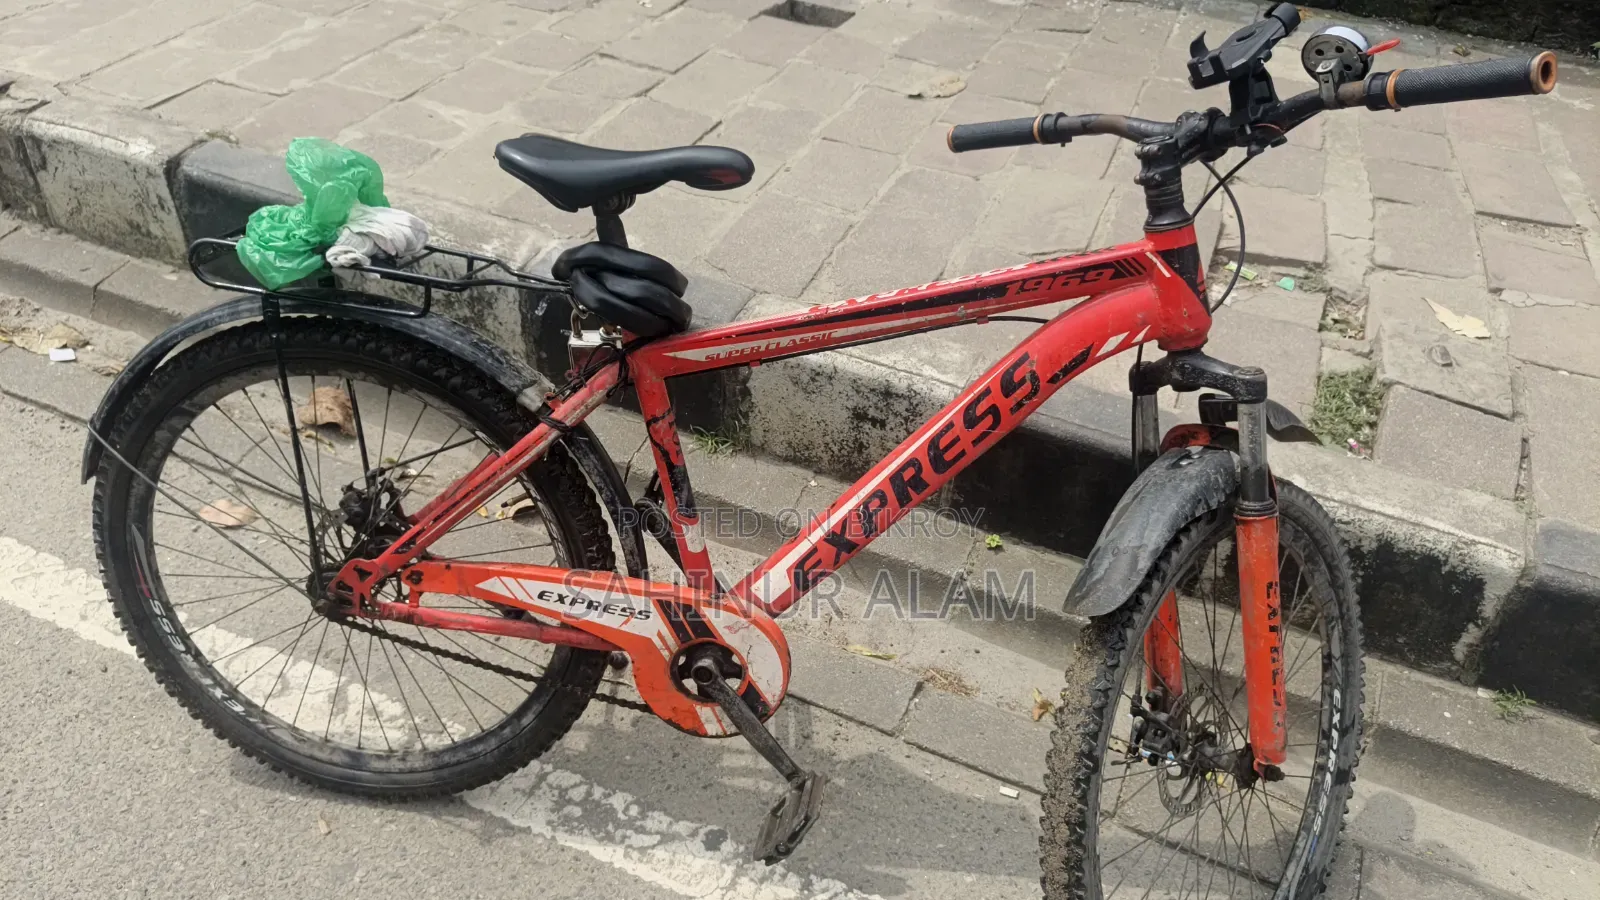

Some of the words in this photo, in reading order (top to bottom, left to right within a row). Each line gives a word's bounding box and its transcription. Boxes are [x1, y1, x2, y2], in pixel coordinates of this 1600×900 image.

[1003, 268, 1115, 298] 1969
[704, 345, 762, 360] SUPER
[764, 330, 838, 352] CLASSIC
[793, 351, 1041, 593] EXPRESS
[536, 589, 653, 621] EXPRESS
[1313, 688, 1341, 836] EXPRESS
